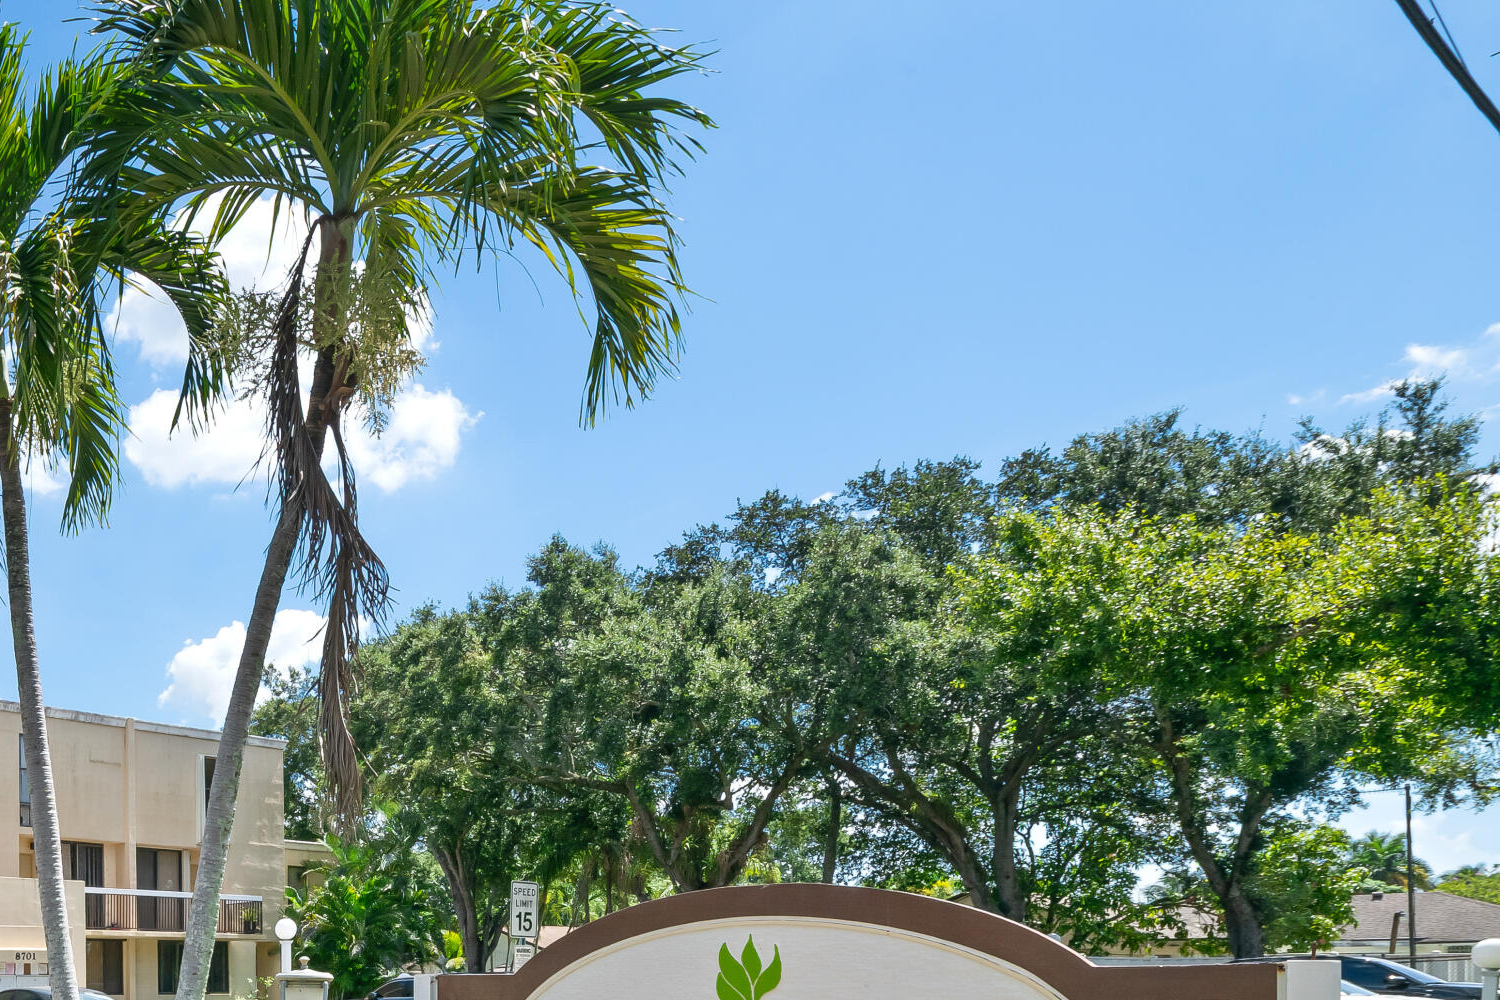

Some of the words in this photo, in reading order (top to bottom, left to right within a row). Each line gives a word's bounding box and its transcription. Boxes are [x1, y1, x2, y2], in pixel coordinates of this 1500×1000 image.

[513, 887, 536, 897] SPEED
[515, 899, 533, 908] LIMIT
[515, 911, 533, 932] 15
[15, 952, 37, 960] 8701
